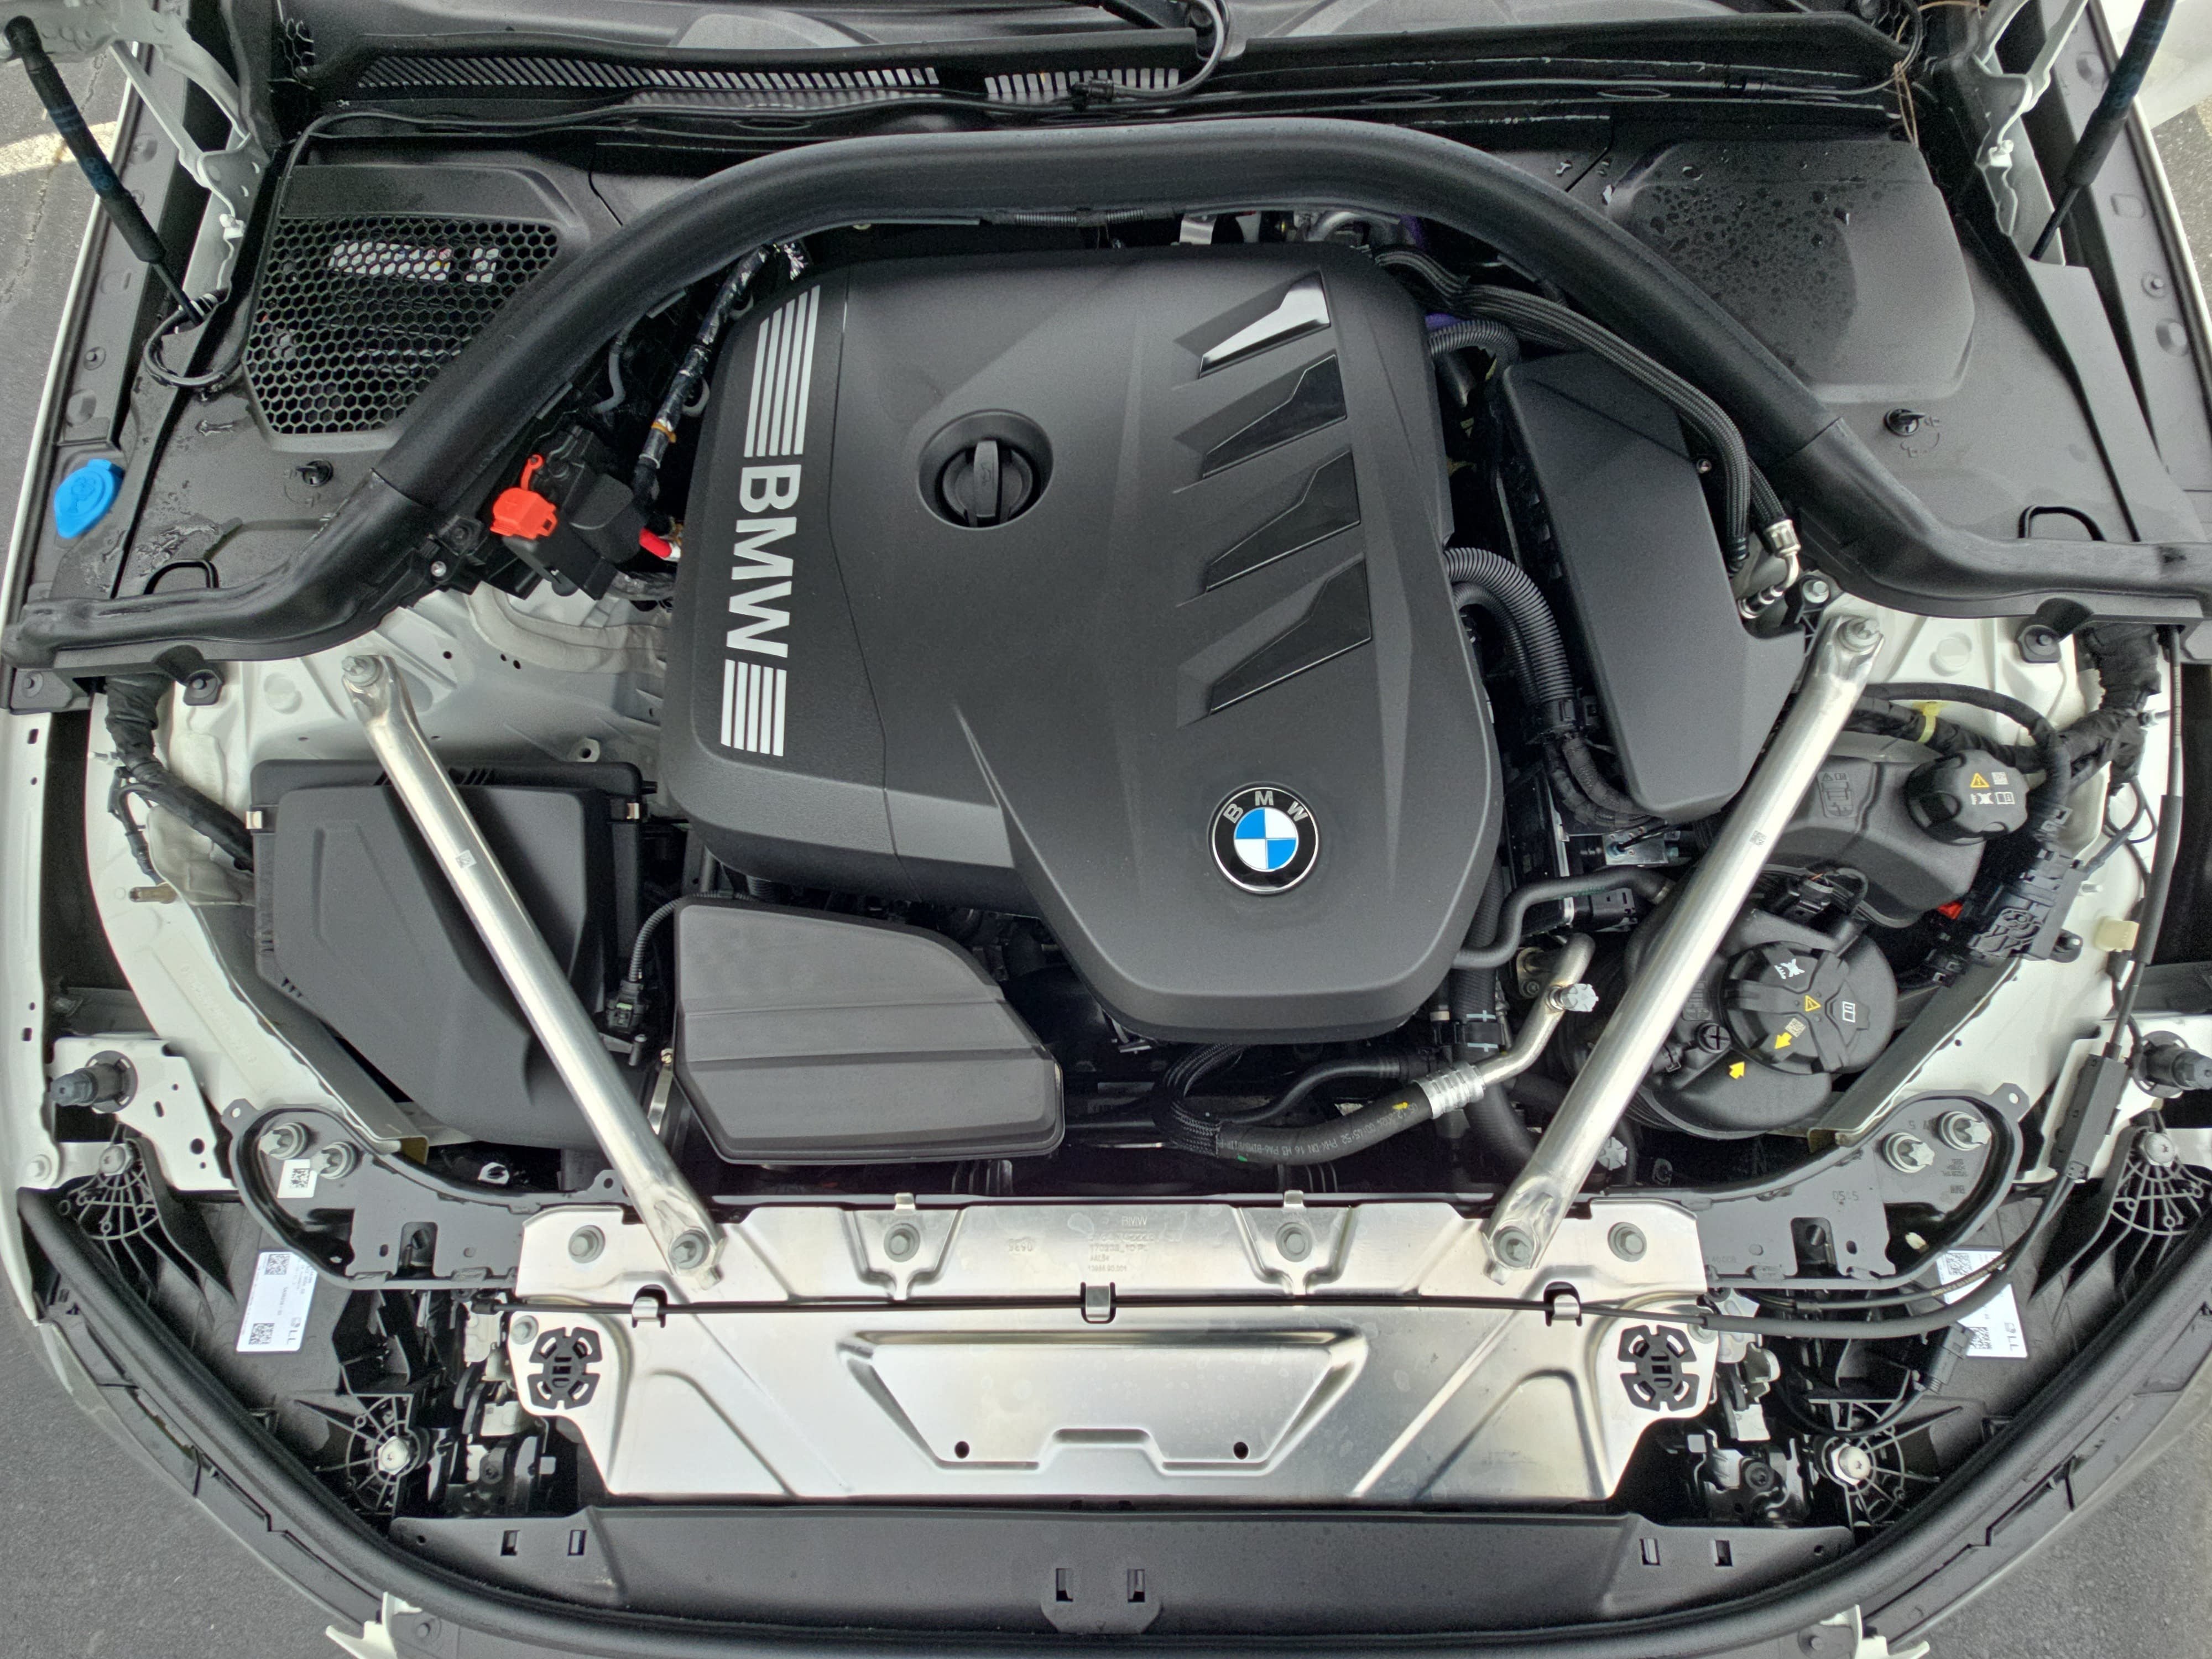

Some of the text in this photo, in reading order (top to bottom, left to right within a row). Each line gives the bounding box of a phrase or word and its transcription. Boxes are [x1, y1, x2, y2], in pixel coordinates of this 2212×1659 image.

[726, 464, 801, 658] BMW
[1223, 791, 1308, 823] BMW
[1121, 1216, 1147, 1226] BMW
